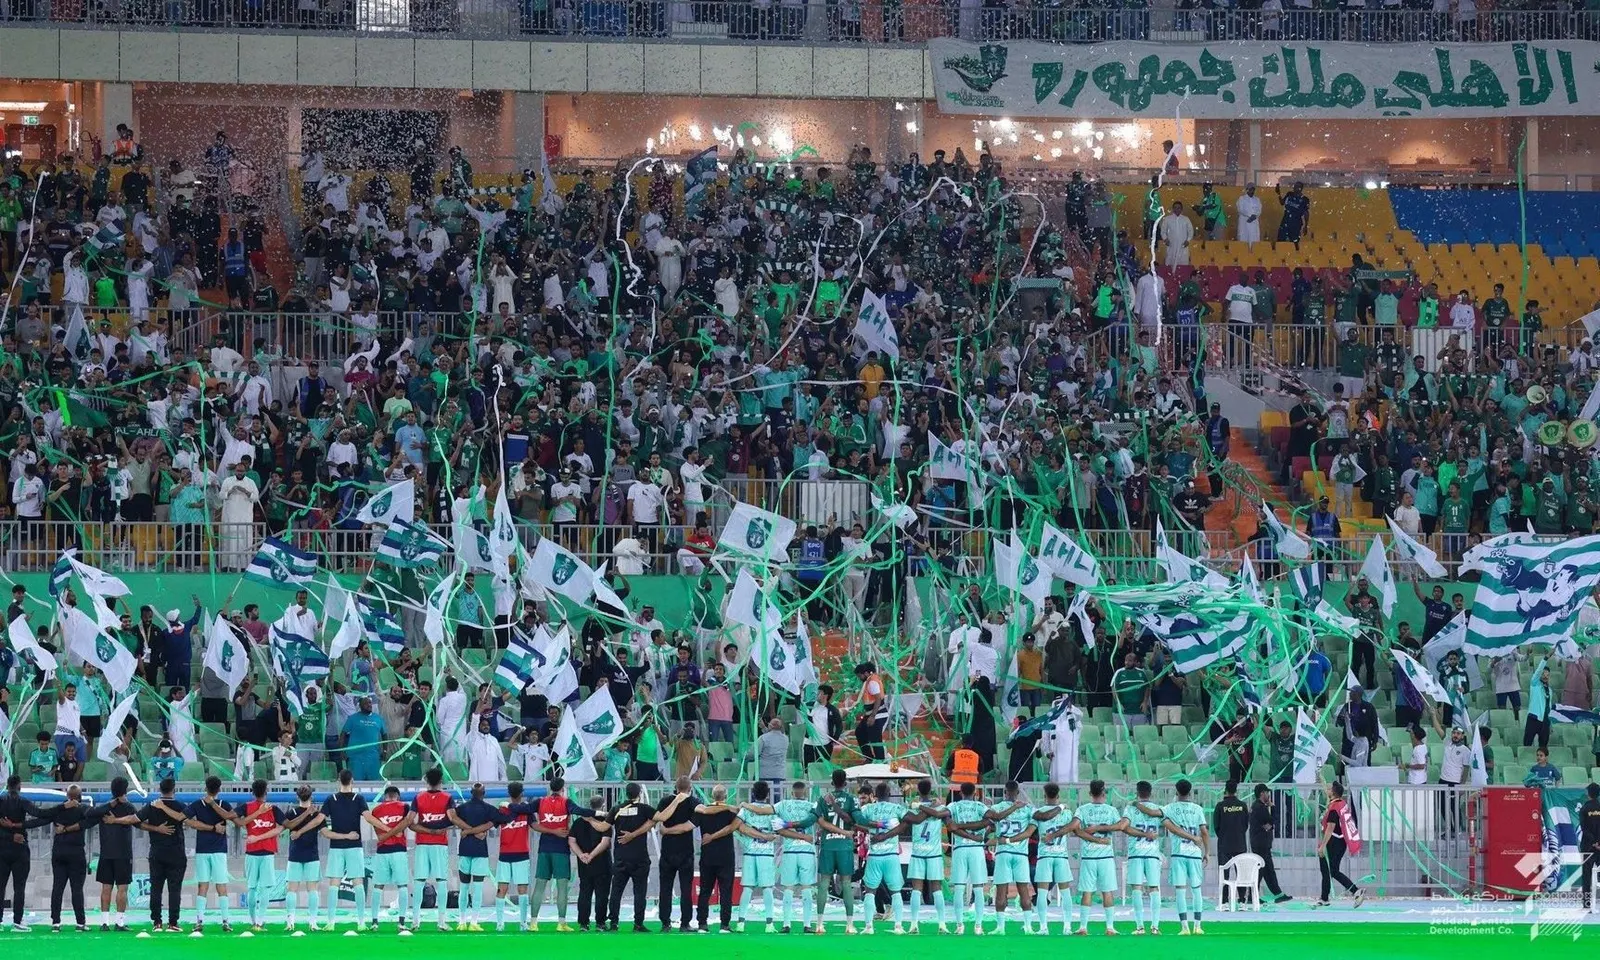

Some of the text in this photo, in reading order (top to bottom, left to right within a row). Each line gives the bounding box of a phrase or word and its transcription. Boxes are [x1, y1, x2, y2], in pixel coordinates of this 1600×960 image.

[1249, 46, 1366, 109] ملك
[1043, 534, 1097, 578] AHLI
[920, 822, 930, 842] 4
